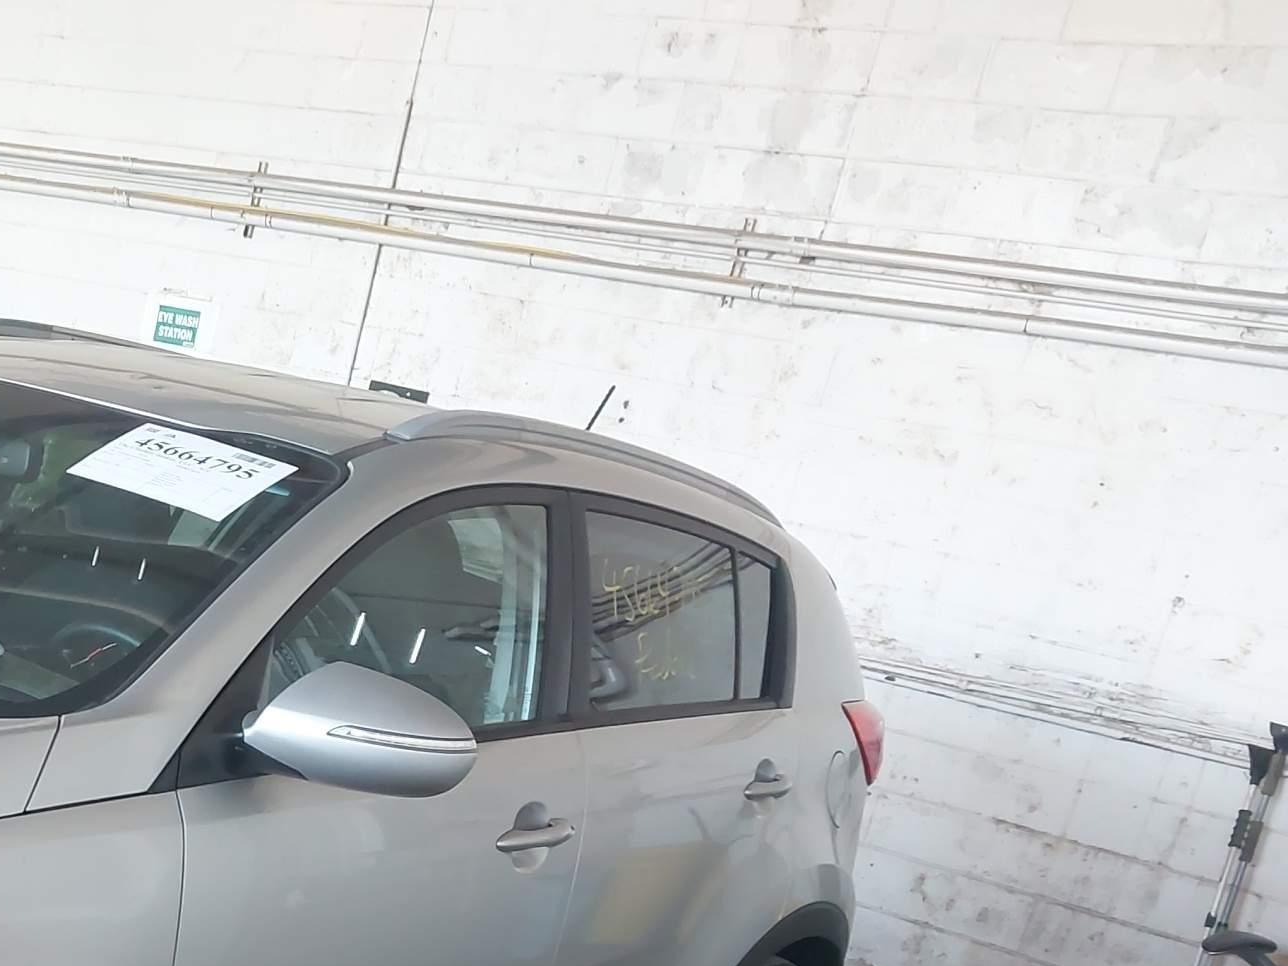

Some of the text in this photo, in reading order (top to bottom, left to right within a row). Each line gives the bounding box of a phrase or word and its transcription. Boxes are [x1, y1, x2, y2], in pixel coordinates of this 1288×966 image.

[158, 311, 200, 329] EYE WASH
[158, 325, 194, 342] STATION
[135, 438, 260, 480] 45664795
